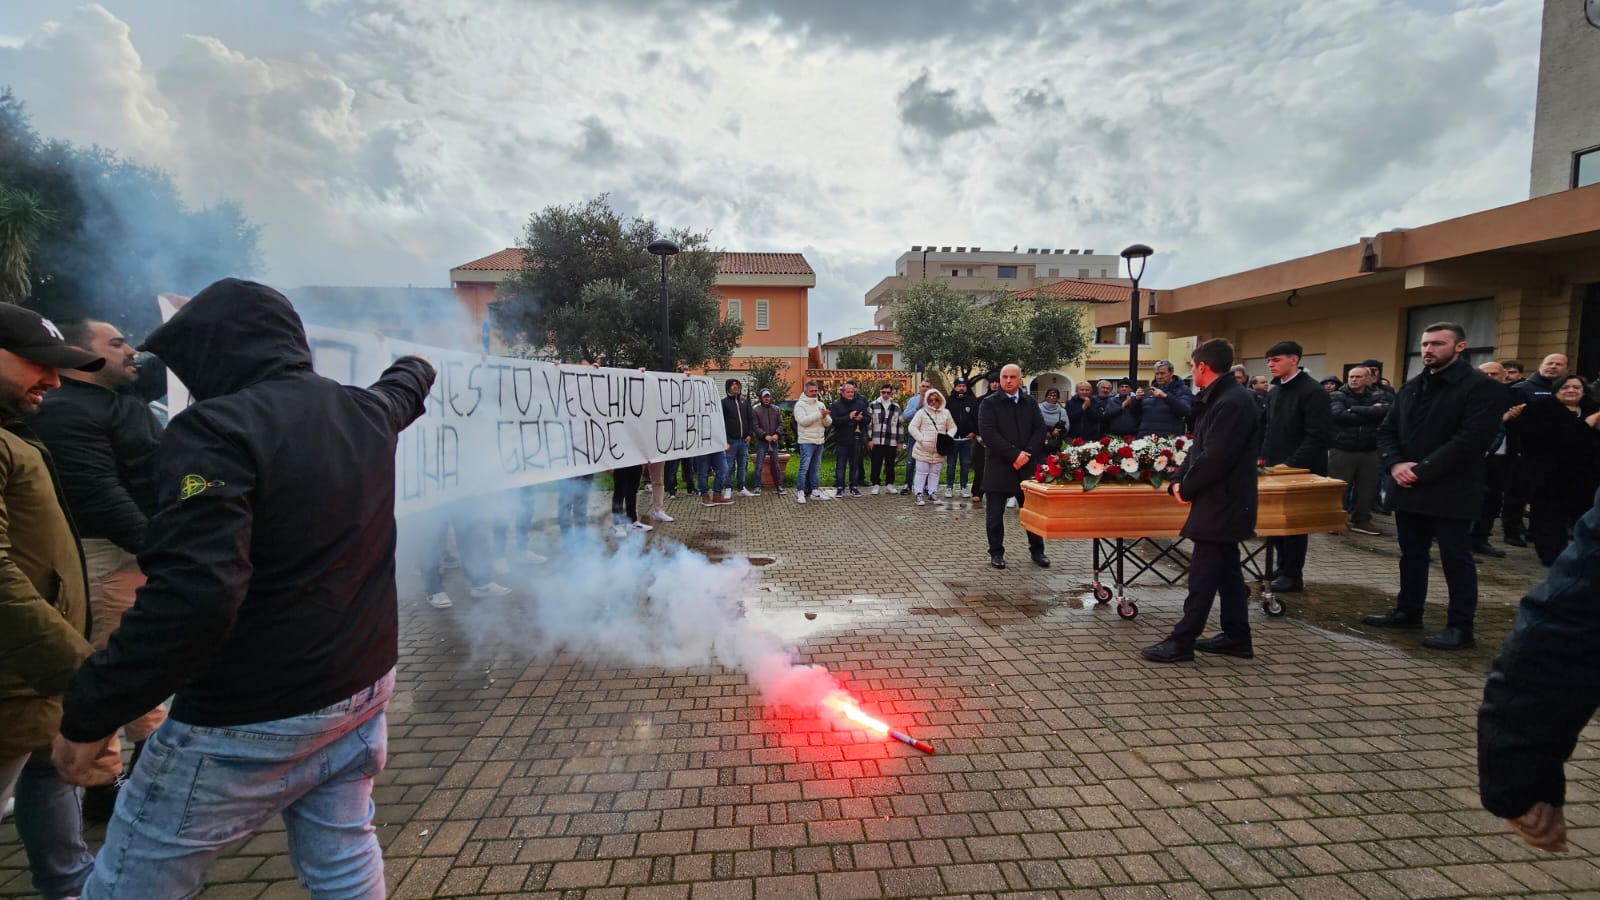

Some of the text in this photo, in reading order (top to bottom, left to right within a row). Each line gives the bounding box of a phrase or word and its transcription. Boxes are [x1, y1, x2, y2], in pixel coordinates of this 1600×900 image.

[542, 369, 645, 418] VECCHIO
[497, 418, 625, 474] GRANDE
[656, 414, 712, 454] OLBIA
